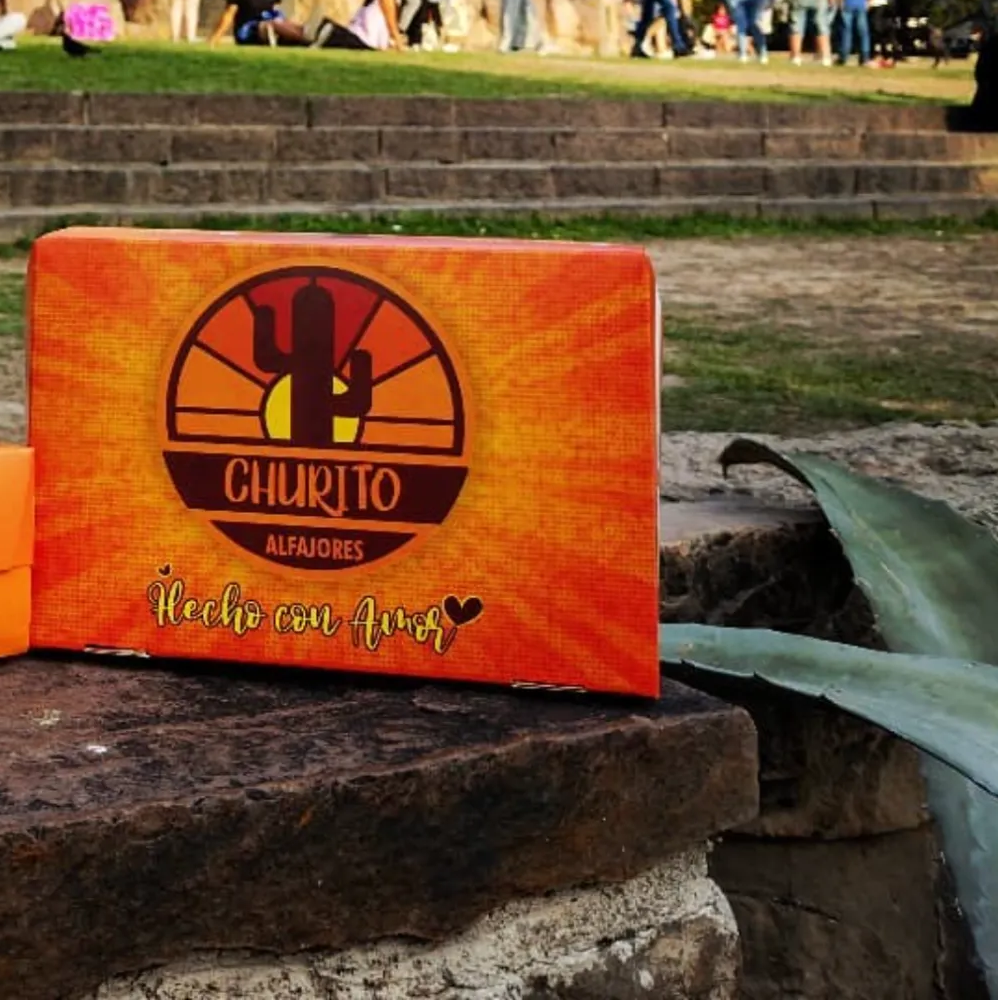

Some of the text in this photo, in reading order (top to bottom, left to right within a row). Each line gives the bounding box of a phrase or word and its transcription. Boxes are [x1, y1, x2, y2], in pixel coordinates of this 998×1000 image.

[224, 457, 401, 517] CHURITO
[265, 534, 364, 561] ALFAJORES
[148, 579, 457, 655] Hecho con Amor
